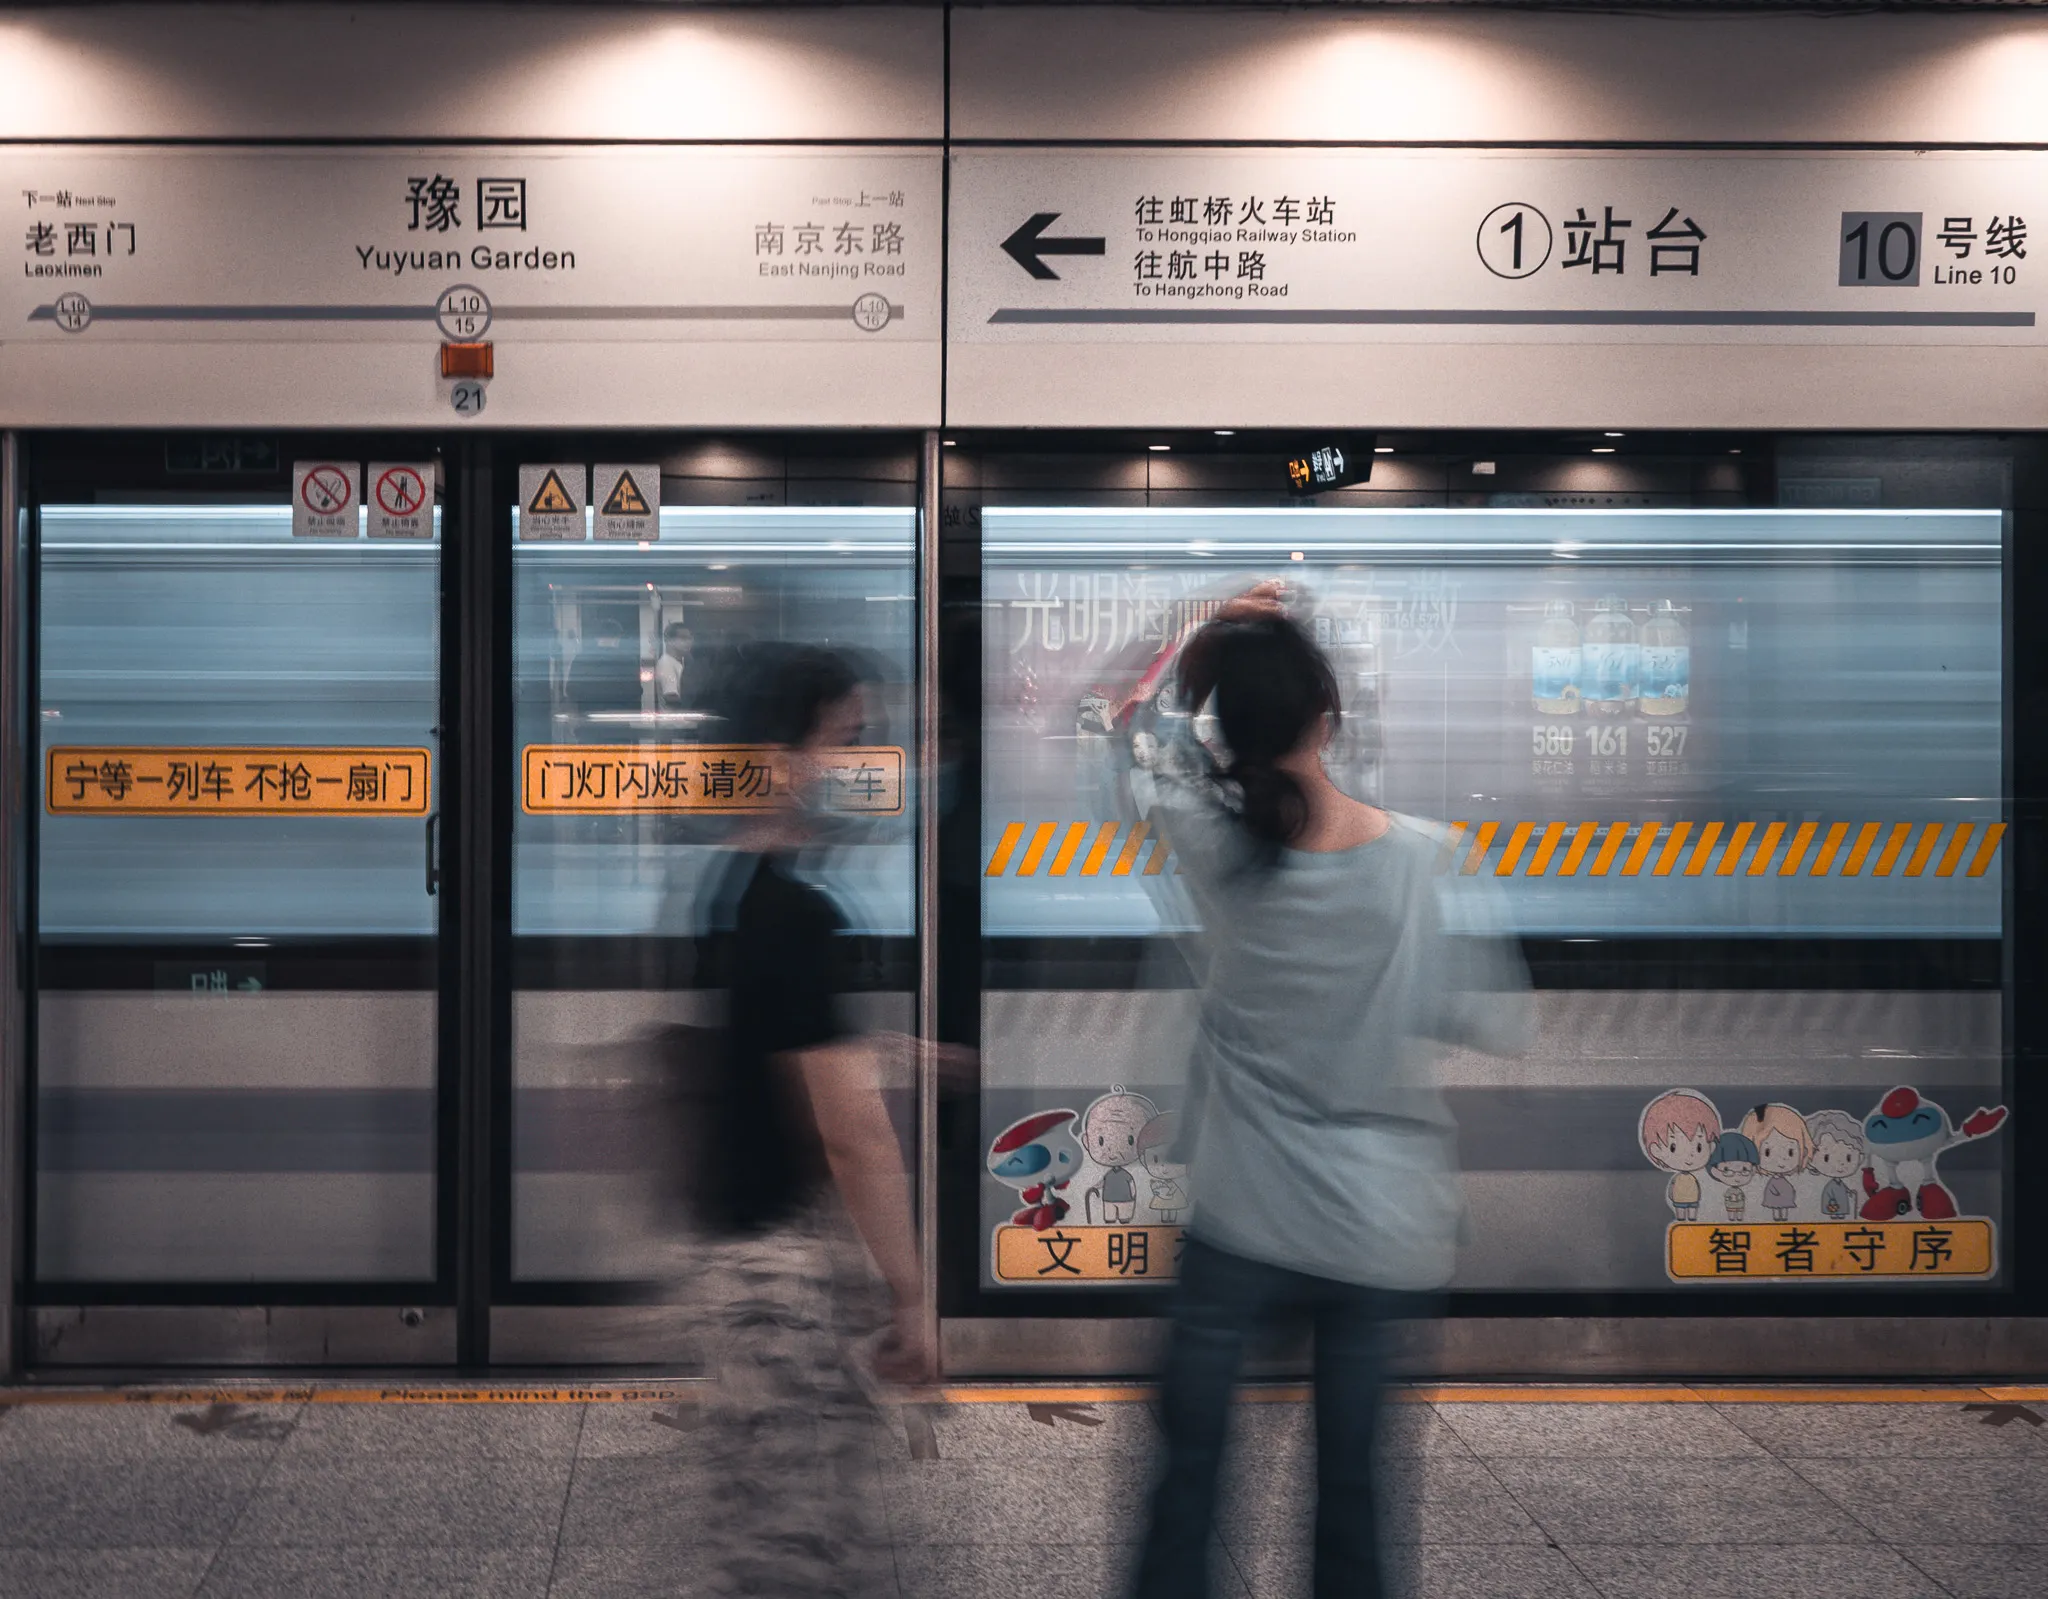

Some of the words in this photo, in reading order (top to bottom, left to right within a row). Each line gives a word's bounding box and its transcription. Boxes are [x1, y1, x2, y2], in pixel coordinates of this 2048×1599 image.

[22, 188, 73, 210] 下一站
[75, 195, 95, 207] Next
[96, 195, 116, 208] Stop
[405, 174, 527, 232] 豫园
[854, 189, 905, 208] 上一站
[1135, 195, 1337, 227] 往虹桥火车站
[24, 220, 137, 258] 老西门
[754, 221, 905, 257] 南京东路
[1136, 228, 1153, 242] To
[1157, 228, 1233, 245] Hongqiao
[1236, 228, 1298, 245] Railway
[1301, 228, 1357, 243] Station
[1845, 219, 1917, 281] 10
[1936, 215, 2028, 260] 号线
[24, 261, 103, 278] Laoximen
[355, 245, 462, 276] Yuyuan
[470, 245, 576, 271] Garden
[758, 262, 796, 277] East
[798, 262, 860, 280] Nanjing
[864, 261, 905, 277] Road
[1134, 249, 1267, 281] 往航中路
[1934, 265, 1984, 285] Line
[1990, 265, 2017, 285] 10
[60, 300, 86, 313] L10
[446, 295, 481, 314] L10
[860, 300, 884, 313] L10
[1134, 283, 1151, 297] To
[1155, 283, 1244, 300] Hangzhong
[1247, 283, 1289, 297] Road
[455, 317, 476, 335] 15
[454, 388, 482, 412] 21
[1532, 725, 1573, 757] 580
[1585, 725, 1628, 757] 161
[1647, 725, 1689, 757] 527
[64, 760, 234, 802] 宁等一列车
[244, 761, 413, 803] 不抢一扇门
[540, 759, 689, 800] 门灯闪烁
[1709, 1226, 1954, 1274] 智者守序
